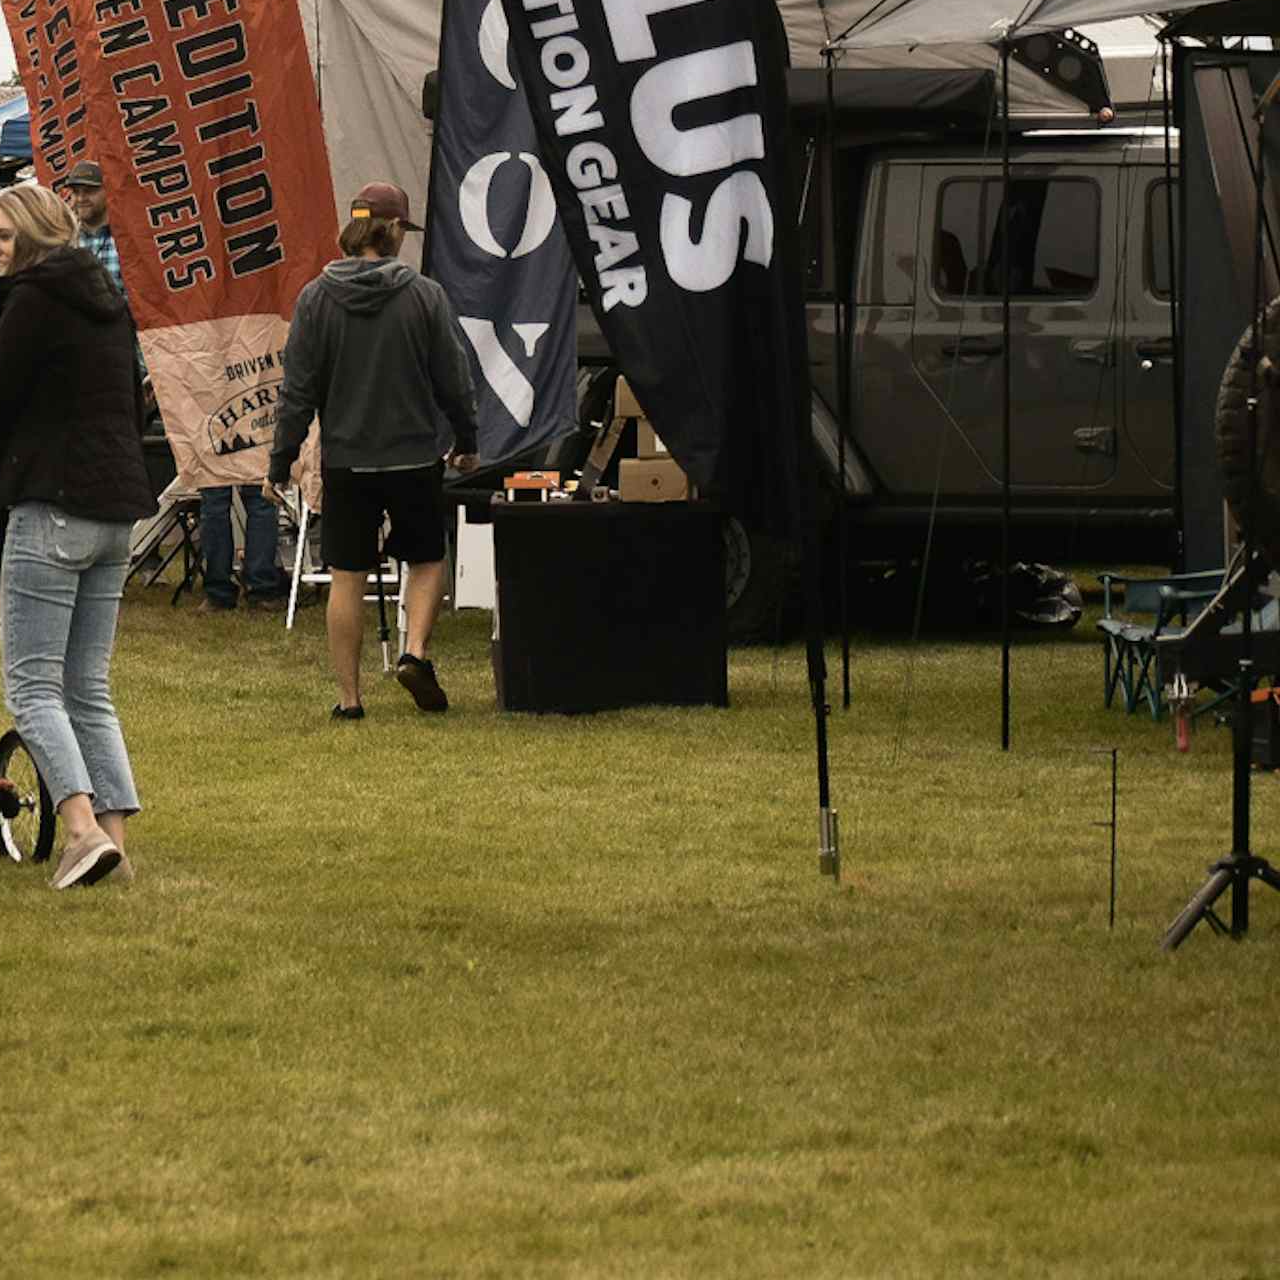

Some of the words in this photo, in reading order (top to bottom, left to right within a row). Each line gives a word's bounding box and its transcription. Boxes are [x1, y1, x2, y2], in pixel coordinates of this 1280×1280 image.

[112, 61, 213, 292] CAMPERS
[564, 139, 649, 315] GEAR
[225, 353, 275, 381] DRIVEN
[251, 407, 278, 429] outd
